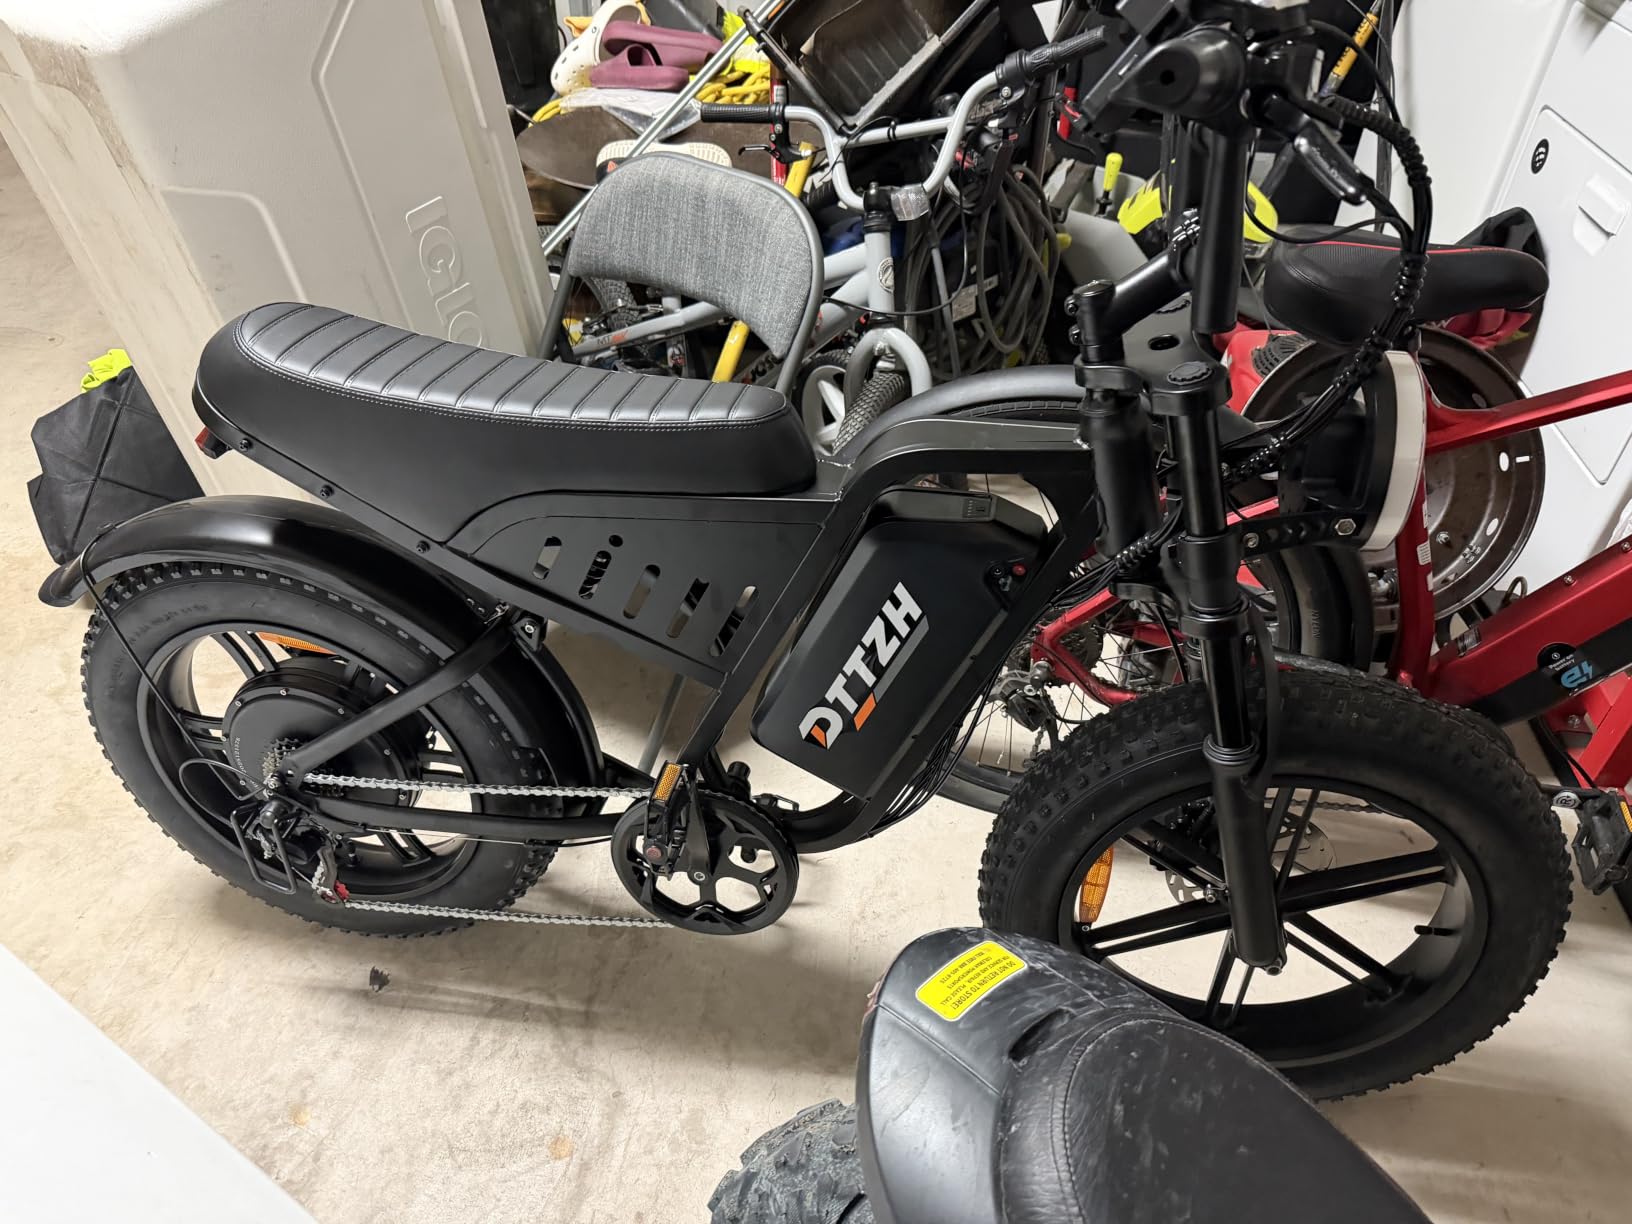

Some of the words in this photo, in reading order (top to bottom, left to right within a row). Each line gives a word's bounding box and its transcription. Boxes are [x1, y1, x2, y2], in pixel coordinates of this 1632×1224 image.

[799, 581, 923, 750] DTTZH
[1548, 658, 1565, 669] Power
[1554, 659, 1575, 671] battery
[998, 965, 1007, 973] NOT
[979, 970, 1000, 986] RETURN
[952, 984, 967, 998] PLEASE
[970, 982, 980, 993] TO
[940, 994, 953, 1006] CALL
[951, 990, 973, 1010] STORE!
